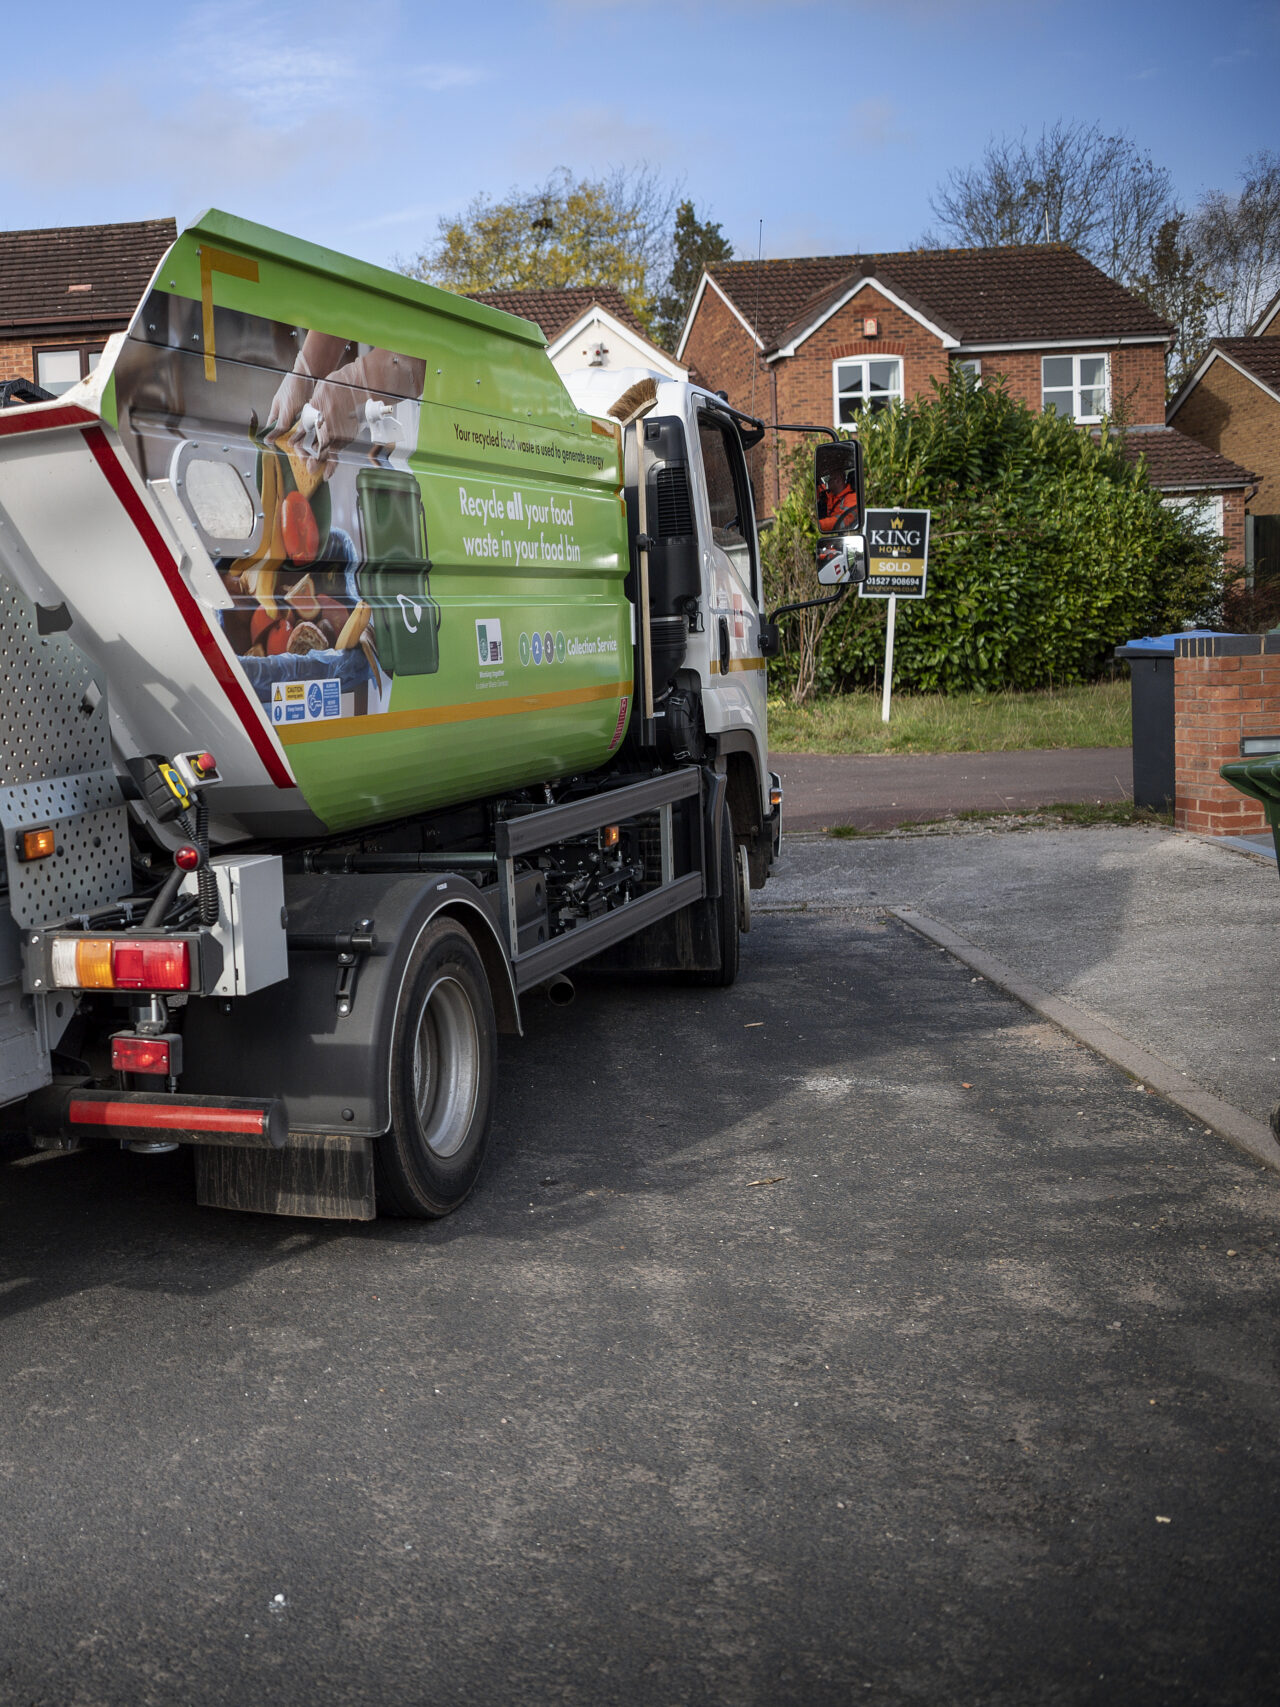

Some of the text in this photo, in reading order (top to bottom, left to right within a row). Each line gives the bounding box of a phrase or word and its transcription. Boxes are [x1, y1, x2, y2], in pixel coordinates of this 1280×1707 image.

[454, 423, 604, 470] Your recycled food waste is used to generate energy
[459, 487, 574, 530] Recycle all your food
[870, 530, 921, 545] KING
[463, 530, 581, 567] waste in your food bin
[878, 562, 911, 572] SOLD
[866, 576, 890, 585] 01527
[567, 636, 597, 656] Collection
[597, 635, 617, 653] Service
